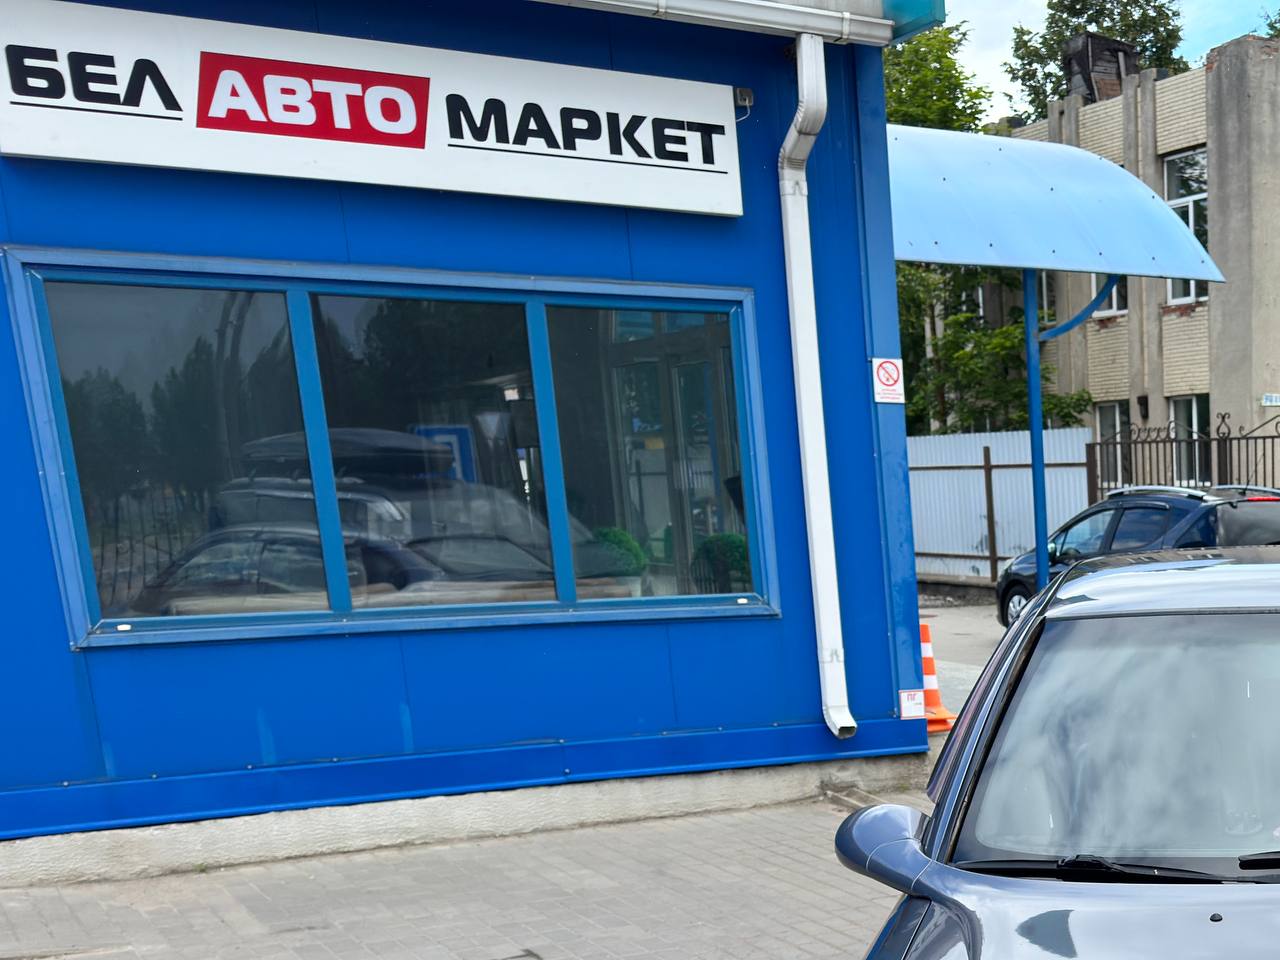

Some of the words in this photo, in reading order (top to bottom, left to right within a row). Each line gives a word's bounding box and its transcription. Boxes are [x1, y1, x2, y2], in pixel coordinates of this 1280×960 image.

[4, 43, 182, 112] БЕЛ
[207, 69, 418, 135] АВТО
[446, 93, 726, 166] МАРКЕТ
